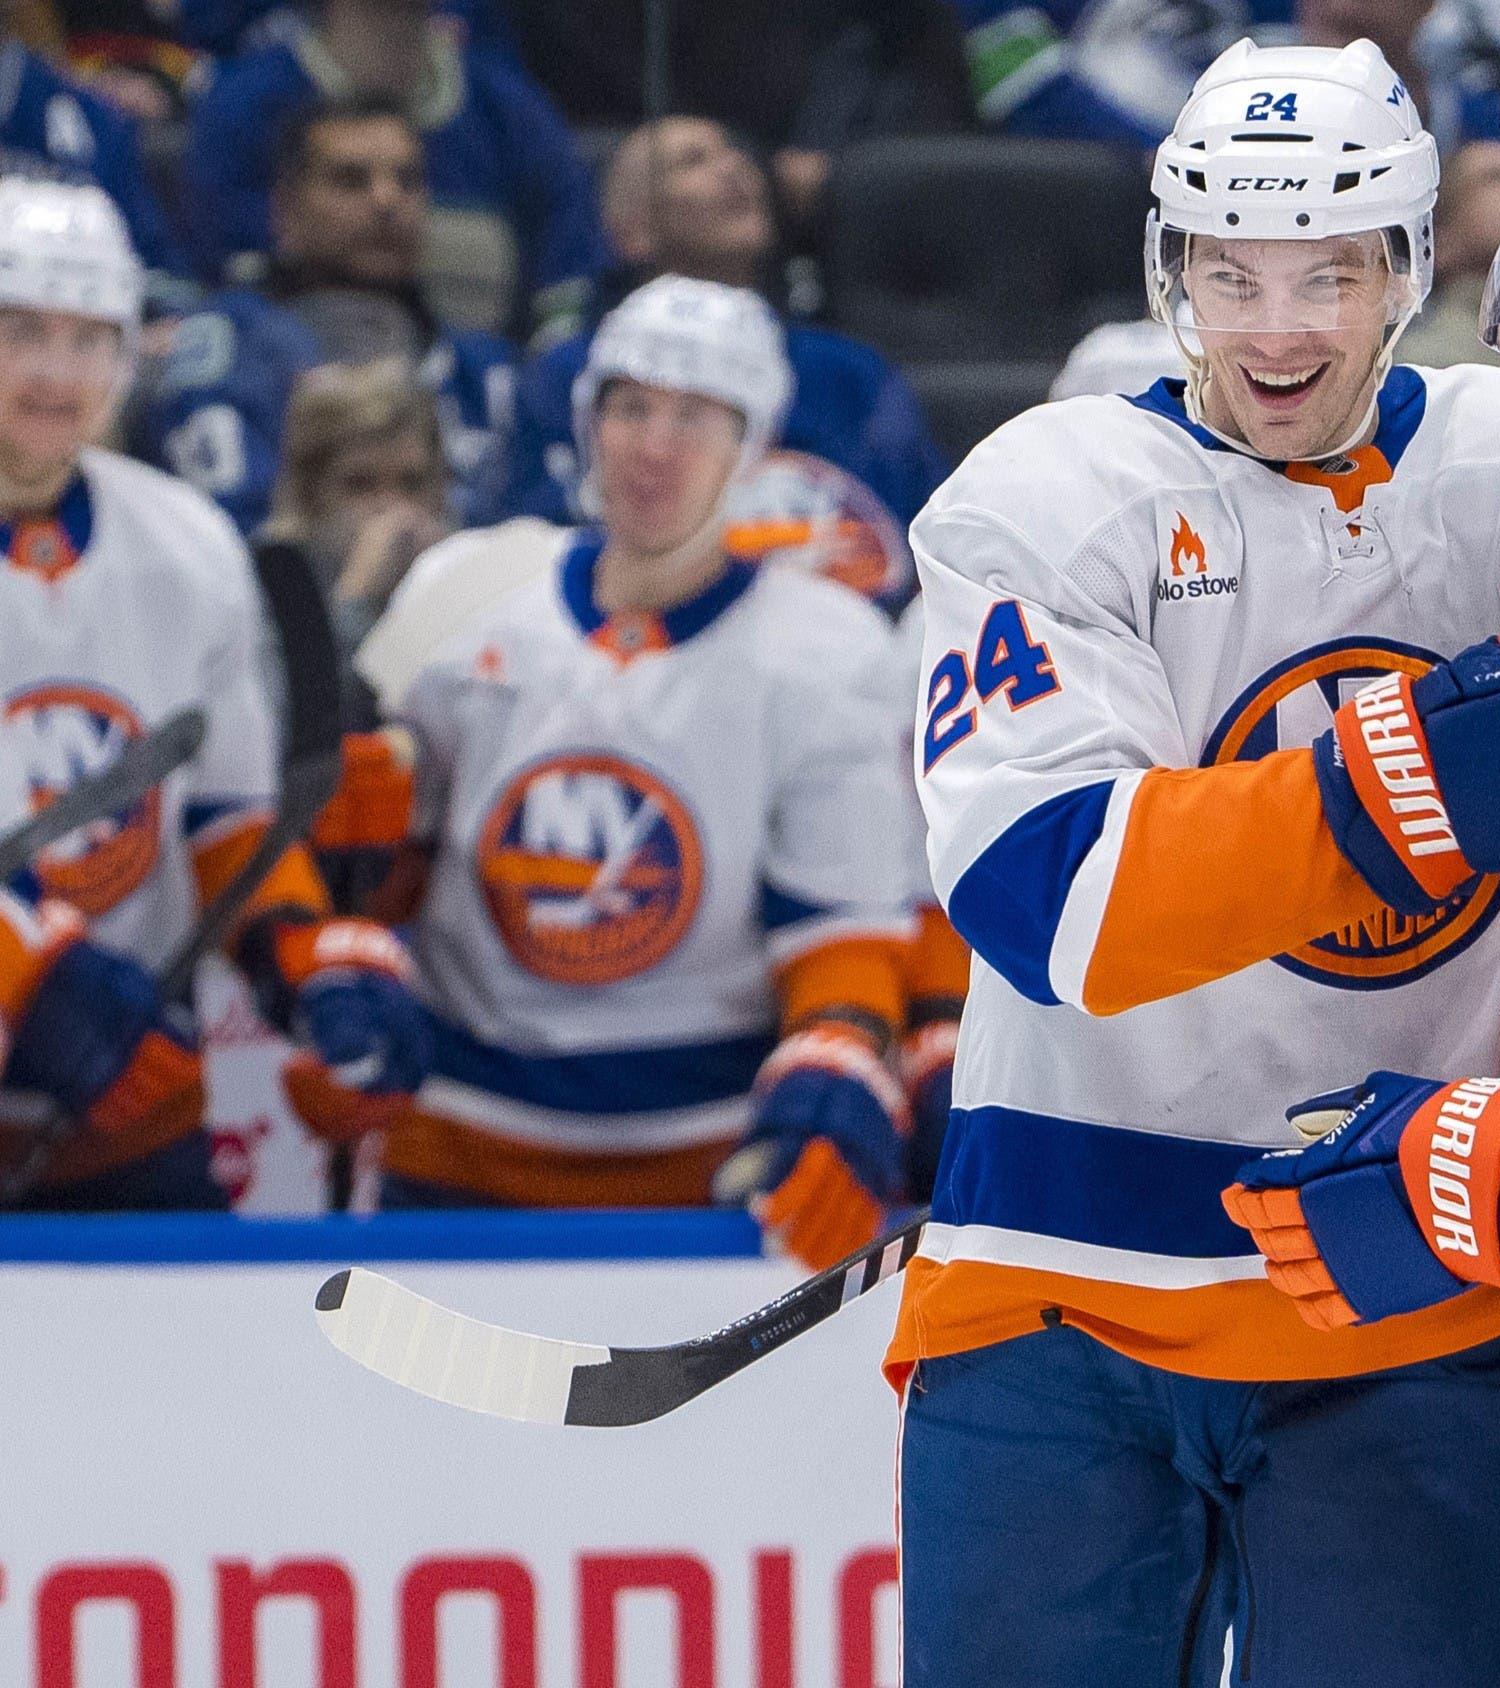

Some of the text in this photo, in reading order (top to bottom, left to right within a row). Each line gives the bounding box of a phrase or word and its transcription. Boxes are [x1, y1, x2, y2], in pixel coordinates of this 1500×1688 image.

[1245, 92, 1298, 122] 24
[1227, 177, 1309, 192] CCM
[1157, 573, 1239, 601] olo stove
[923, 596, 1063, 778] 24
